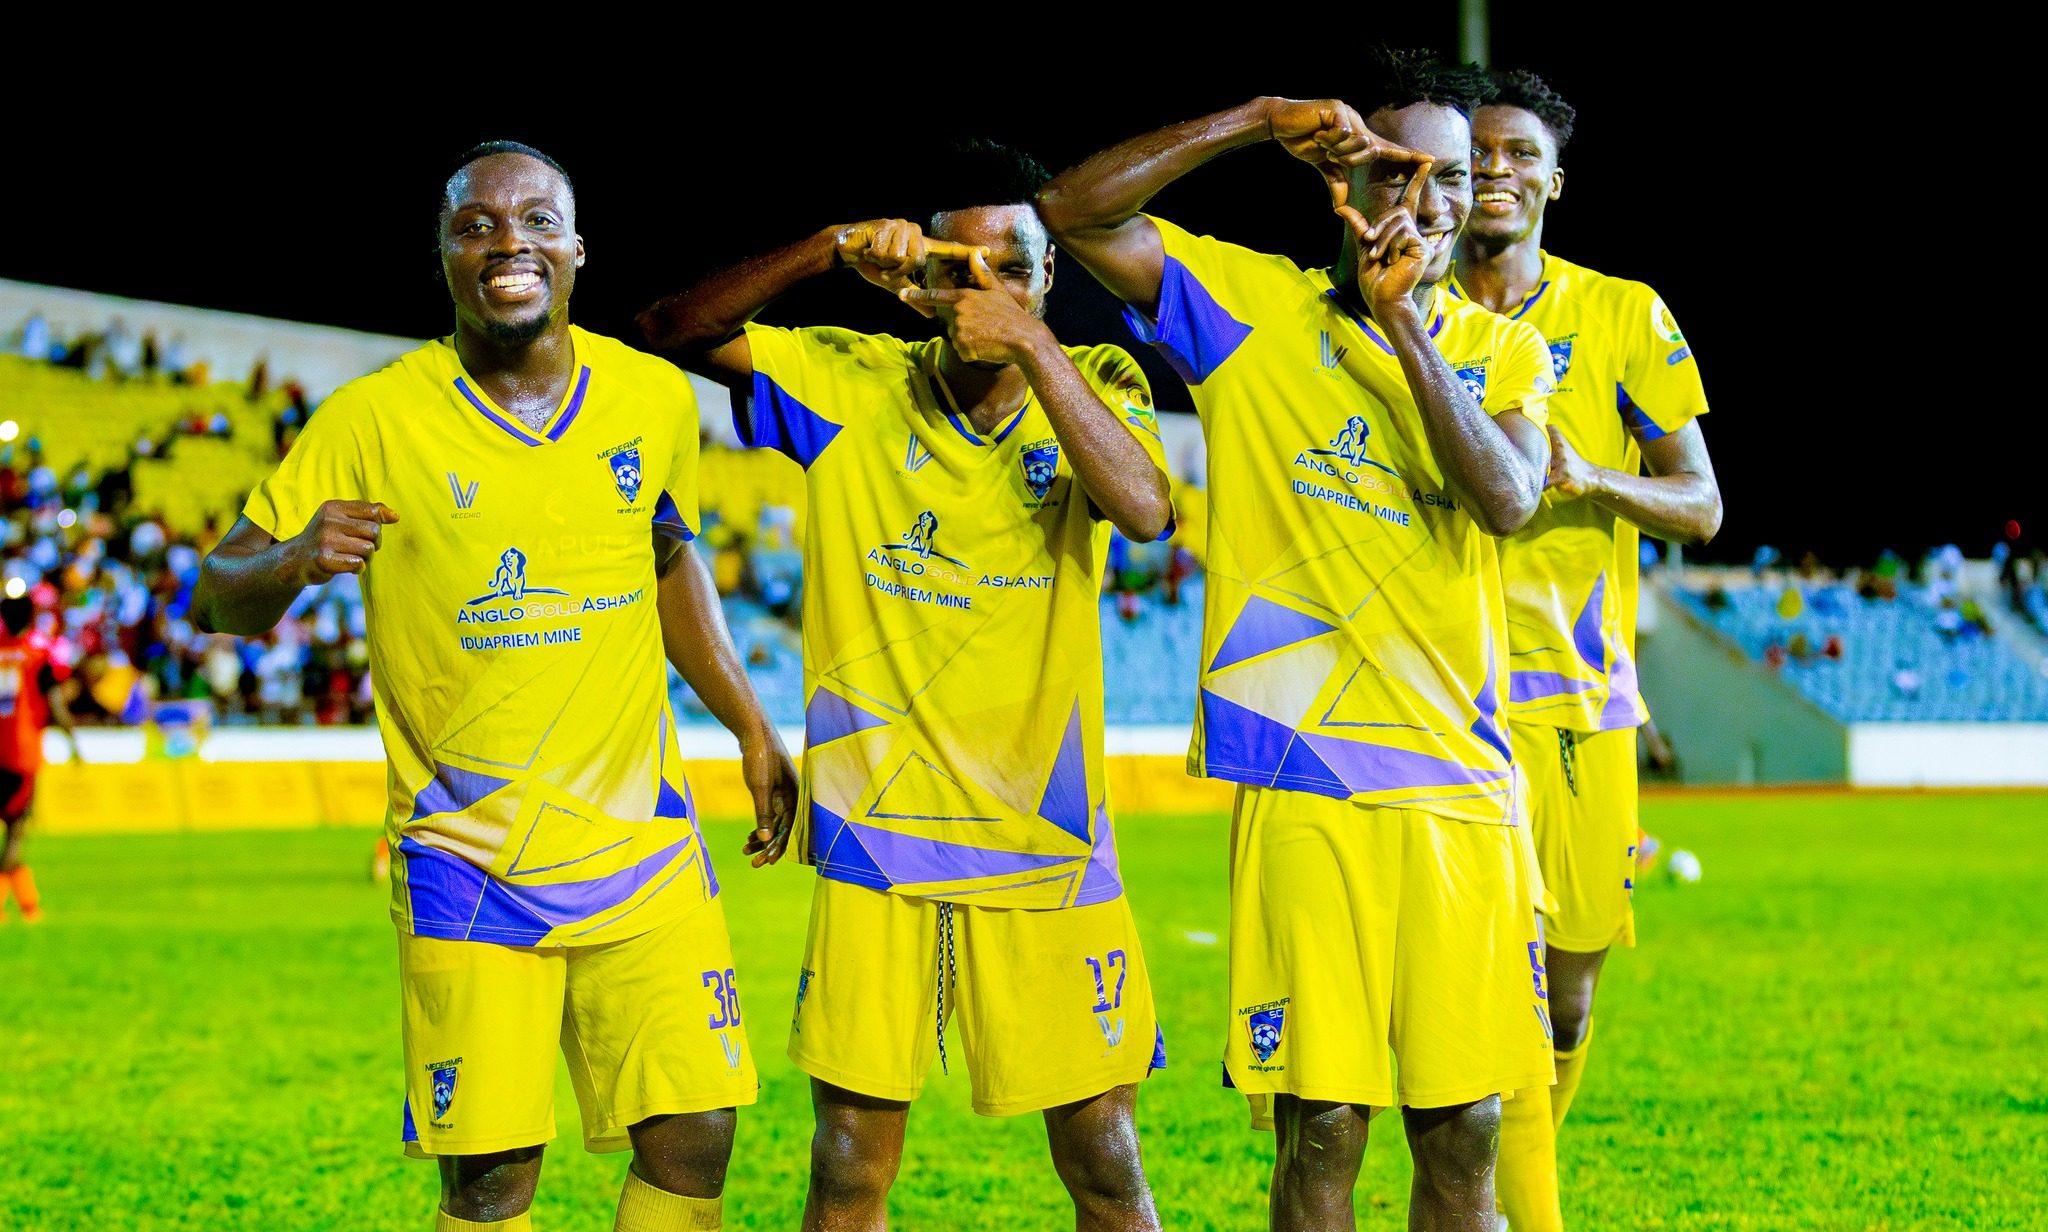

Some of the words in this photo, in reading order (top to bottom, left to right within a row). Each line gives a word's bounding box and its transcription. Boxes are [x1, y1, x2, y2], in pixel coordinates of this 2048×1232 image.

[1472, 367, 1485, 376] SC
[625, 448, 639, 460] SC
[1043, 446, 1059, 456] SC
[1292, 479, 1371, 514] IDUAPRIEM
[1374, 504, 1411, 527] MINE
[935, 592, 972, 610] MINE
[460, 631, 540, 650] IDUAPRIEM
[543, 627, 582, 645] MINE
[1084, 949, 1126, 1014] 17
[701, 967, 741, 1030] 36
[1268, 1009, 1284, 1020] SC
[445, 1067, 456, 1078] SC
